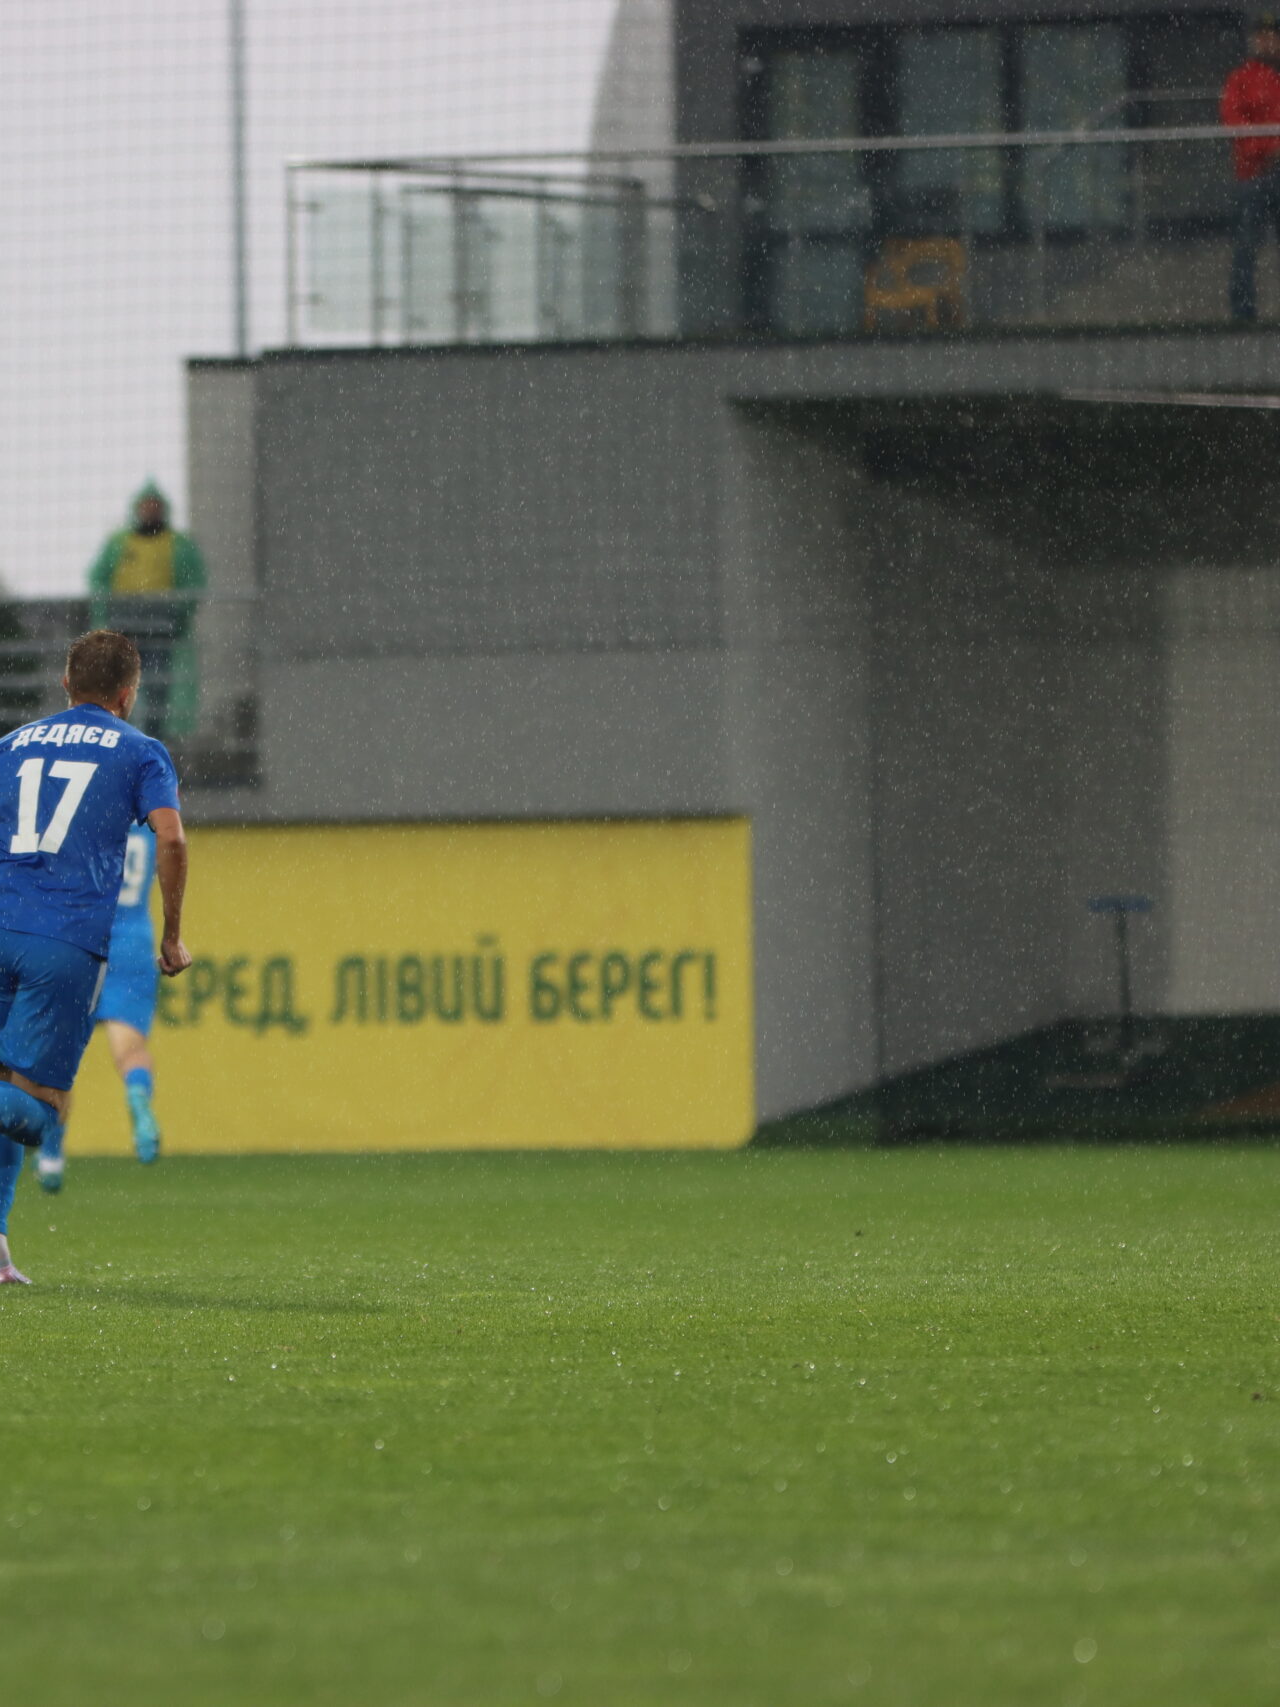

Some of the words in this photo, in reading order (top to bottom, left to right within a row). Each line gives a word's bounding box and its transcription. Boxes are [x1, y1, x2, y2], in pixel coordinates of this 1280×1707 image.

[10, 723, 121, 752] ДЕДЯЄВ
[9, 757, 99, 855] 17
[156, 956, 309, 1036] ЕРЕД
[329, 932, 508, 1026] ЛІВИЙ
[529, 950, 718, 1025] БЕРЕГ!
